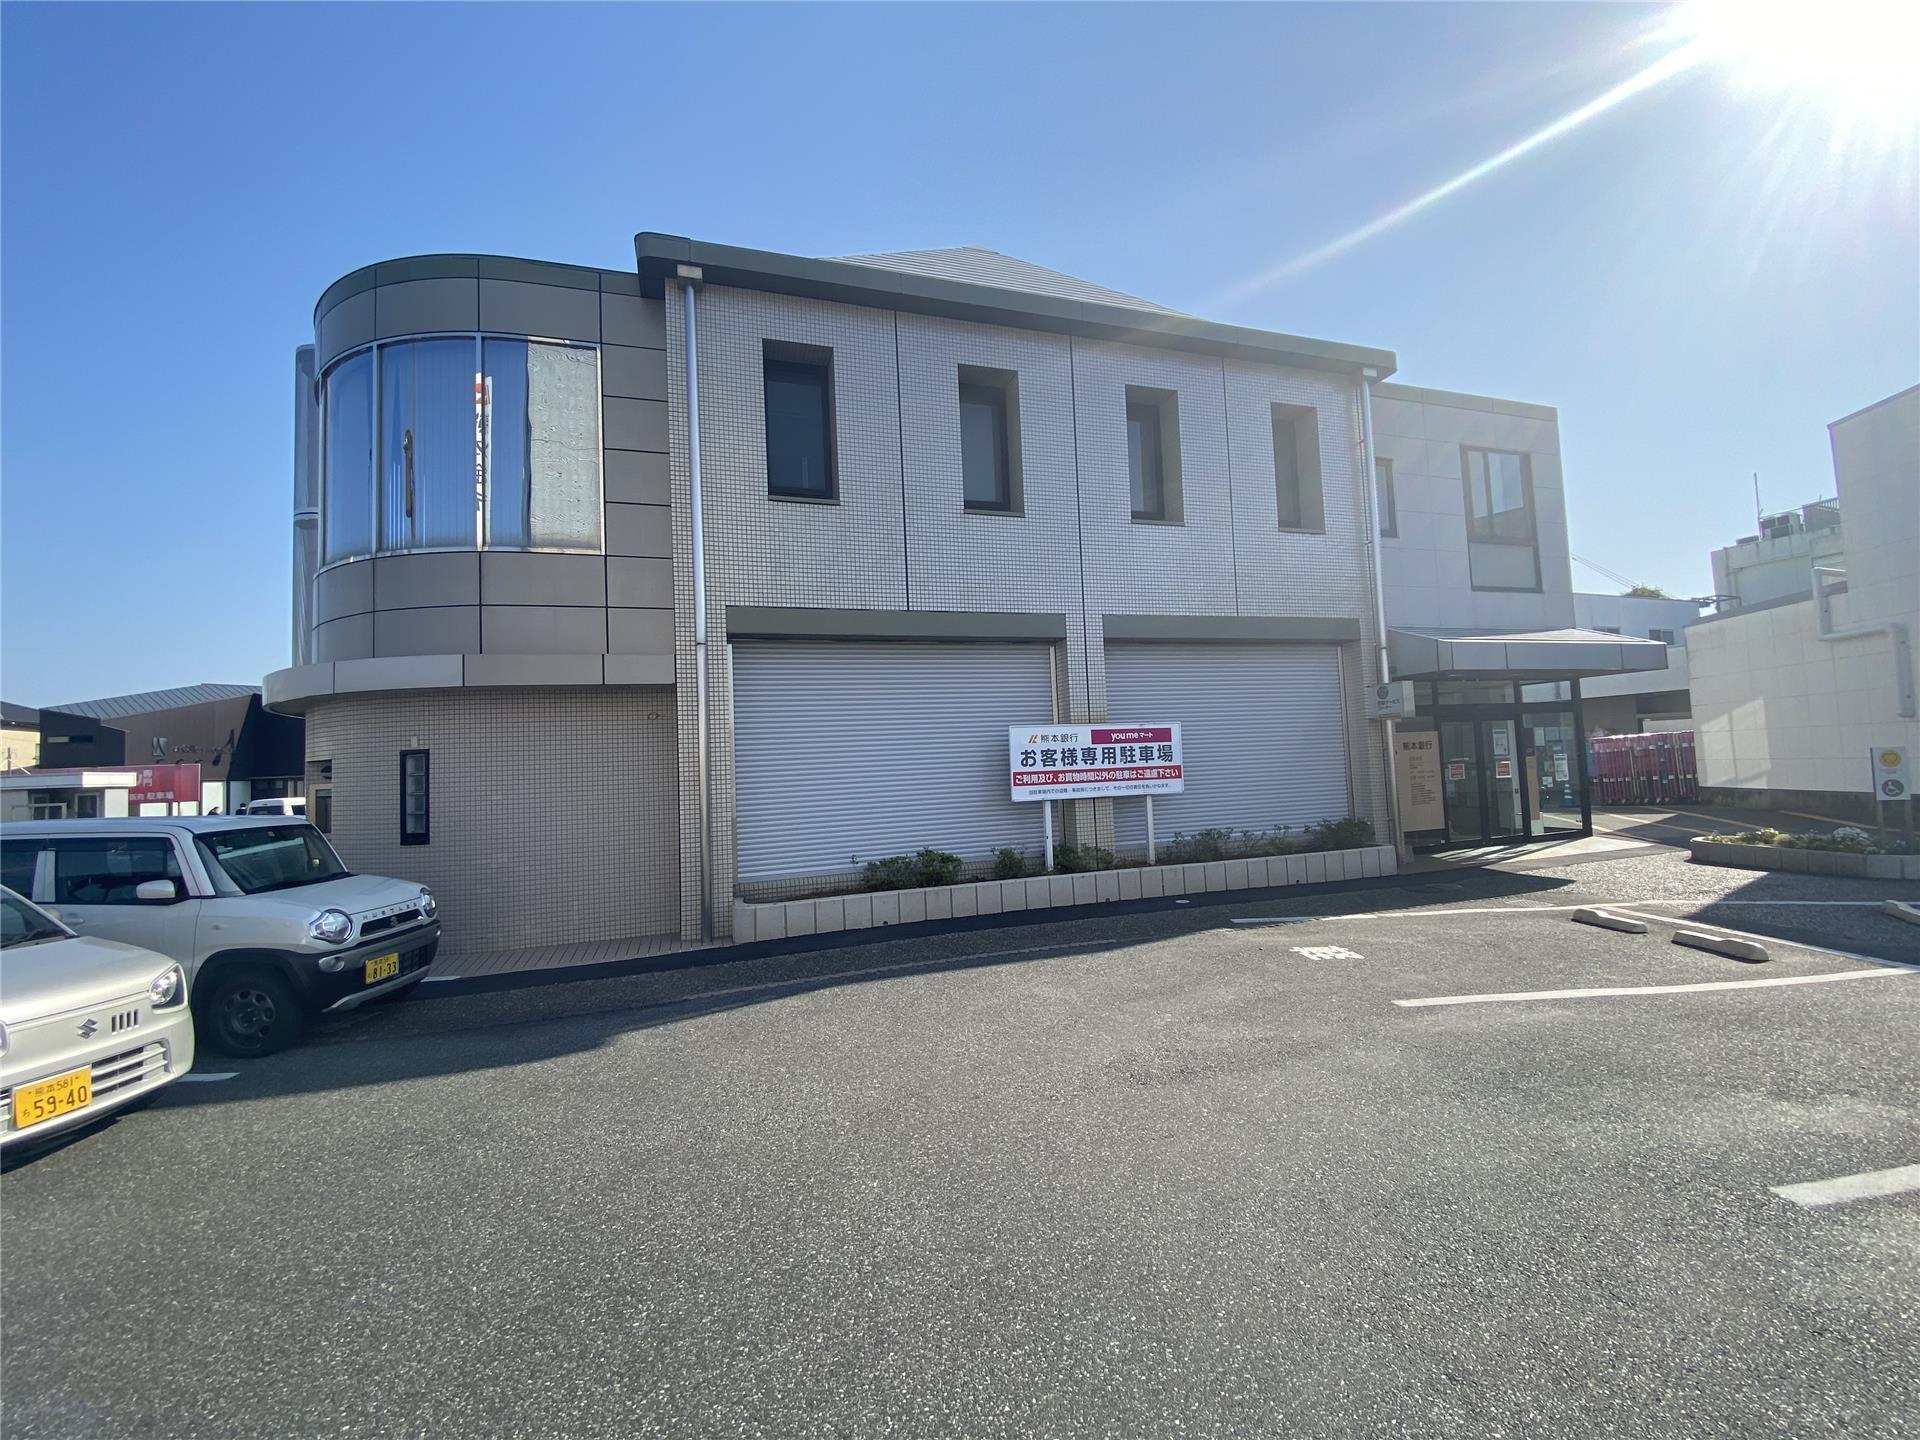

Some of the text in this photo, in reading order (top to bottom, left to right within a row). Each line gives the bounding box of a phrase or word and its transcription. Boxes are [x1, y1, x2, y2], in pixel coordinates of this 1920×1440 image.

[1040, 733, 1079, 743] 熊本銀行
[1020, 744, 1173, 768] お客様専用駐車場
[33, 1085, 87, 1118] 59-40
